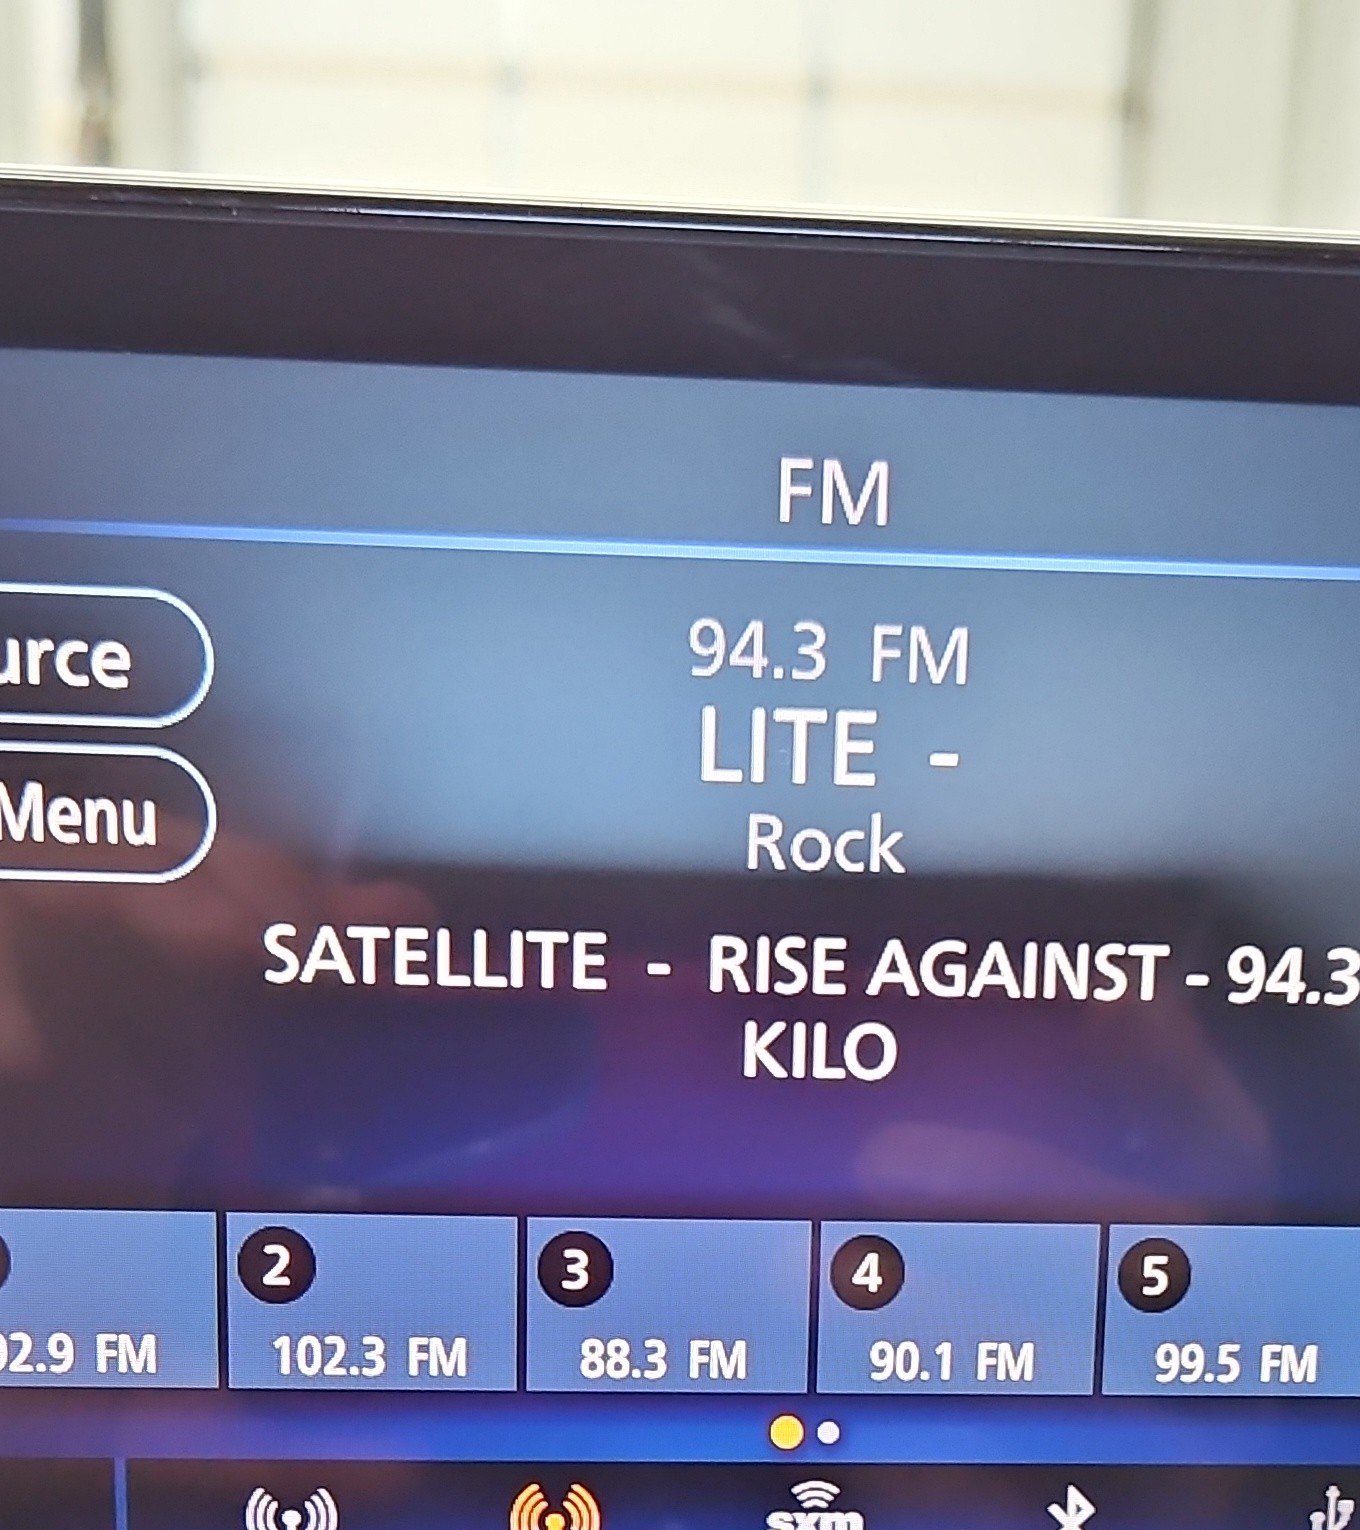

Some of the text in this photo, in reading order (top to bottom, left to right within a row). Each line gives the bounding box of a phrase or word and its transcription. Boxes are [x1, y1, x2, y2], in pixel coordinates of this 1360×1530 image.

[779, 456, 889, 526] FM
[689, 617, 968, 685] 94.3 FM
[700, 705, 877, 786] LITE
[746, 813, 906, 876] Rock
[263, 923, 608, 990] SATELLITE
[709, 934, 847, 996] RISE
[865, 938, 1171, 1002] AGAINST
[743, 1020, 898, 1082] KILO
[262, 1244, 291, 1286] 2
[561, 1248, 589, 1290] 3
[851, 1252, 883, 1293] 4
[1142, 1255, 1169, 1296] 5
[95, 1333, 157, 1374] FM
[272, 1334, 467, 1377] 102.3 FM
[579, 1338, 746, 1380] 88.3 FM
[869, 1340, 1034, 1382] 90.1 FM
[1154, 1342, 1319, 1384] 99.5 FM
